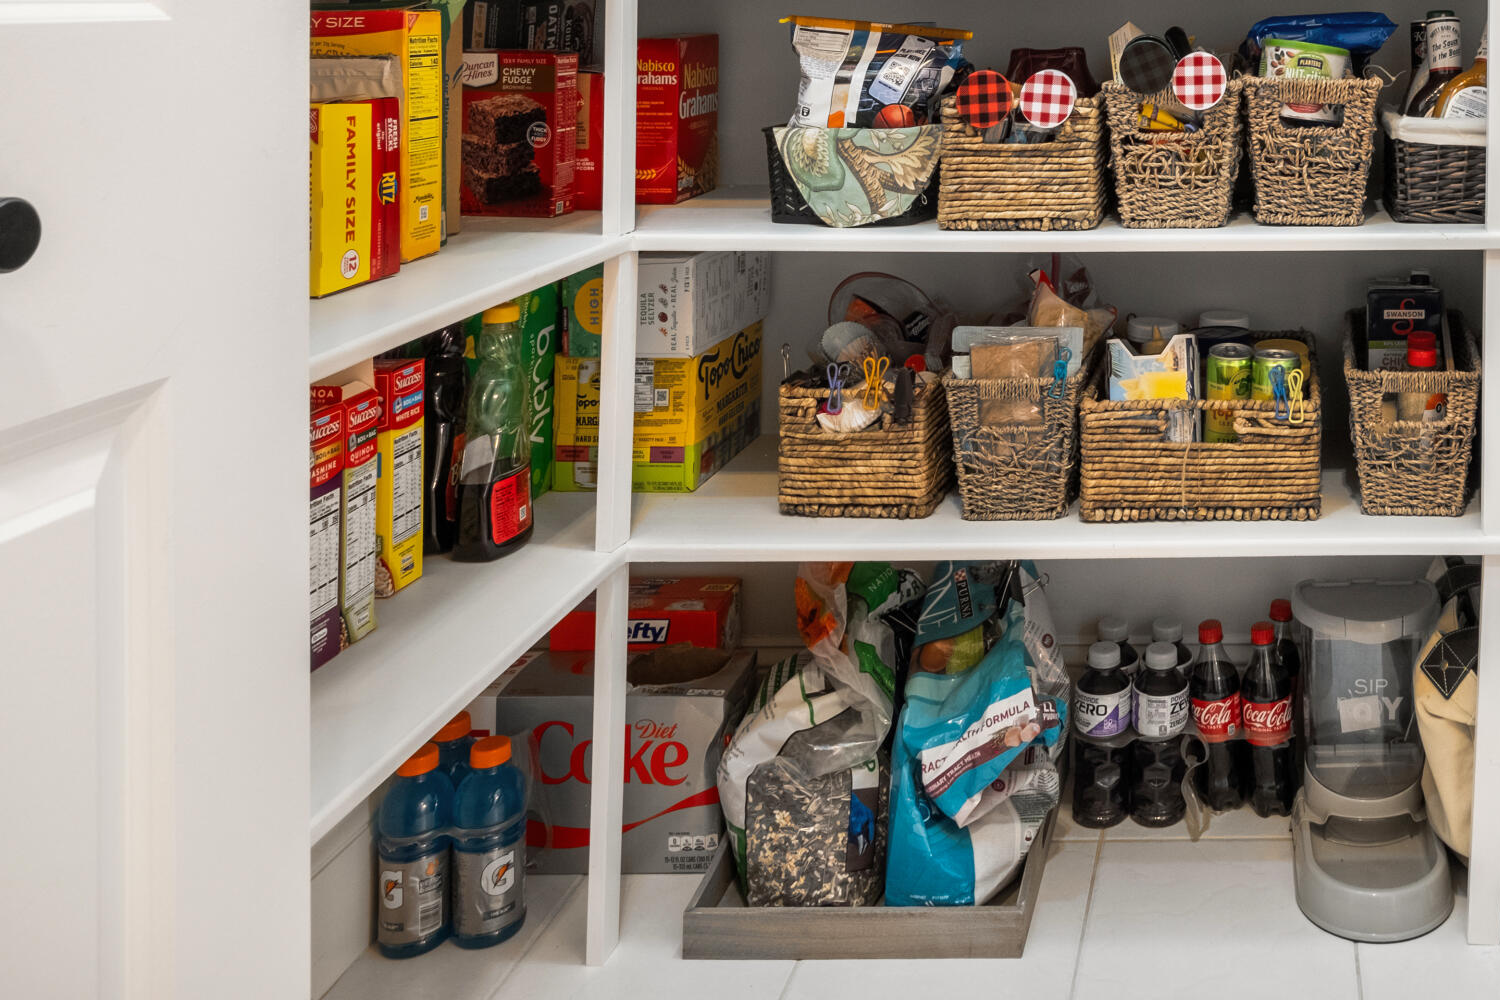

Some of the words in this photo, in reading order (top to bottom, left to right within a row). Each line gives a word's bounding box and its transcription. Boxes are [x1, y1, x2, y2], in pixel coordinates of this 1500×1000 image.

[325, 16, 366, 29] SIZE
[462, 60, 495, 73] Duncan
[464, 69, 493, 81] Hines
[502, 67, 536, 76] CHEWY
[502, 76, 532, 84] FUDGE
[637, 72, 678, 86] rahams
[345, 116, 357, 190] FAMILY
[382, 172, 396, 206] RITZ
[345, 197, 356, 243] SIZE
[349, 255, 357, 272] 12
[589, 287, 600, 326] HIGH
[640, 293, 648, 325] TEQUILA
[731, 331, 761, 380] Chico
[395, 371, 422, 391] Success
[349, 406, 377, 428] Success
[576, 416, 600, 427] MARG
[350, 444, 374, 462] QUINOA
[311, 460, 337, 478] ASMINE
[956, 580, 973, 619] PURINA
[628, 622, 665, 642] fty
[1354, 678, 1388, 695] SIP
[1192, 699, 1232, 726] a-Cola
[1243, 699, 1292, 728] Coca-Cola
[635, 719, 678, 739] Diet
[922, 755, 947, 775] RACT
[480, 850, 515, 896] G
